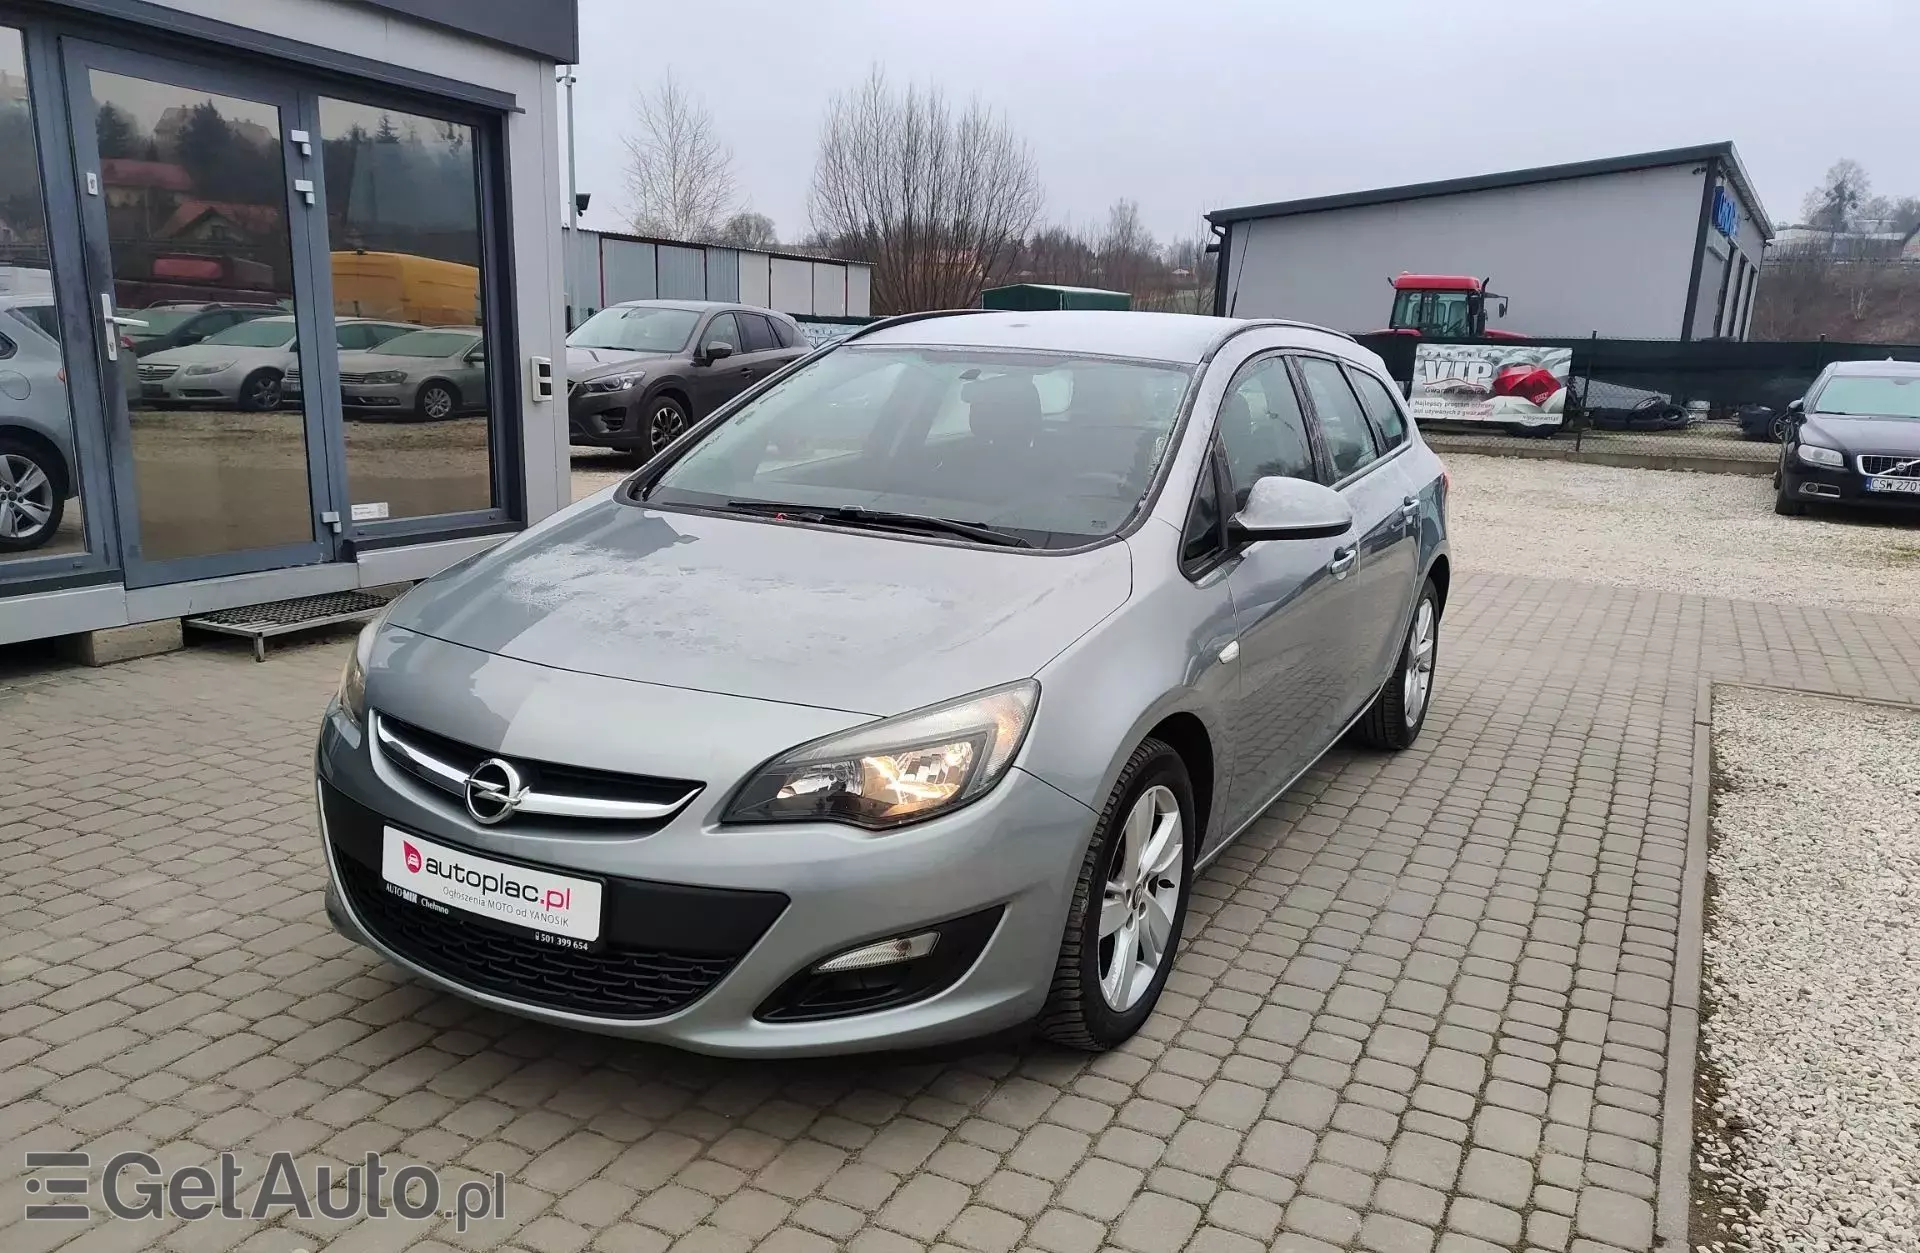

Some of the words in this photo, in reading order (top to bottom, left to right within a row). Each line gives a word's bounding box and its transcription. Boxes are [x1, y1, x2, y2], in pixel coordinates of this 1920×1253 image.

[1424, 359, 1493, 385] VIP
[1872, 479, 1893, 489] CSW
[1896, 481, 1920, 491] 270
[426, 857, 570, 912] autoplac.pl
[443, 887, 486, 907] Ogłoszenia
[487, 899, 514, 915] MOTO
[515, 907, 527, 918] od
[529, 910, 569, 928] YANOSIK
[541, 933, 554, 944] 501
[557, 938, 571, 948] 399
[573, 942, 588, 951] 654
